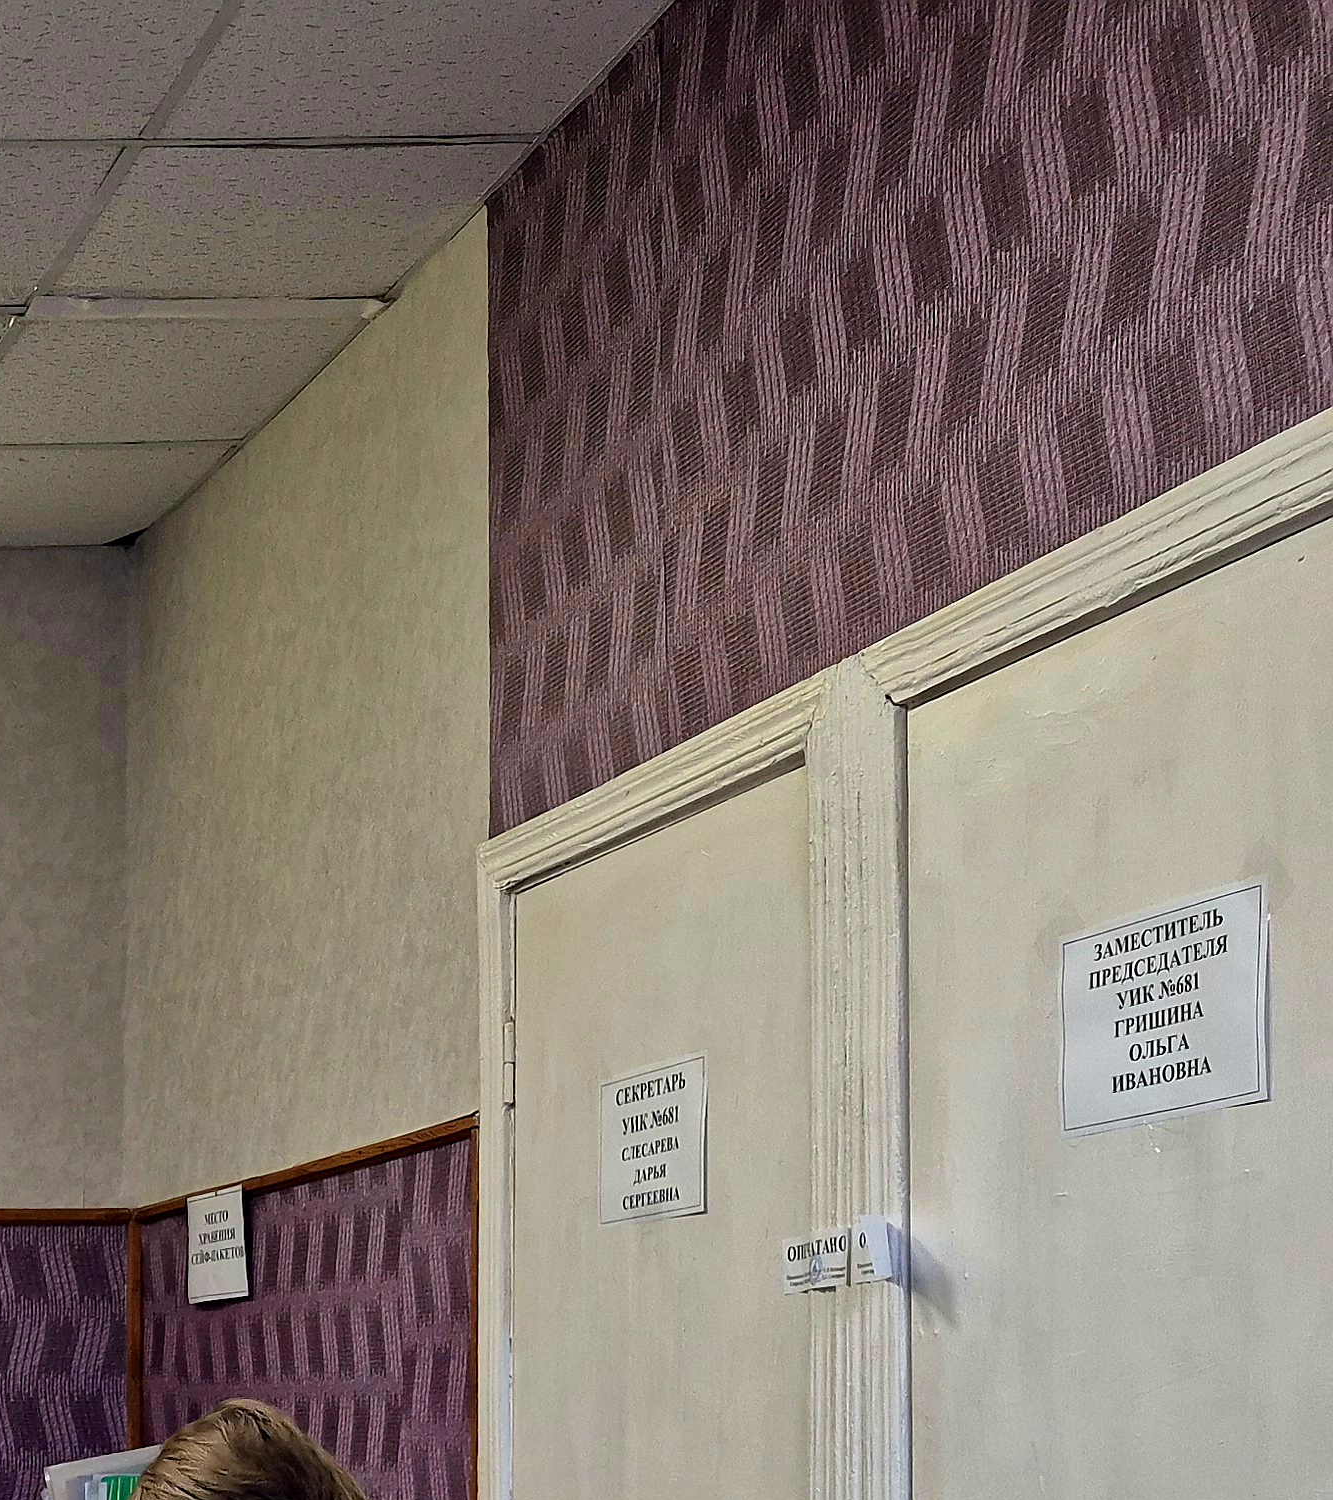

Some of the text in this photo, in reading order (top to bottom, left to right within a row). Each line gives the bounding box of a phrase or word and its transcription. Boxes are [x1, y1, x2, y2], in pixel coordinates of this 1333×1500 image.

[1093, 908, 1224, 961] ЗАМЕСТИТЕЛЬ
[1088, 934, 1229, 990] ПРЕДСЕДАТЕЛЯ
[1116, 971, 1200, 1010] УИК №681
[1113, 1000, 1204, 1038] ГРИШИНА
[1129, 1033, 1190, 1062] ОЛЬГА
[615, 1071, 686, 1107] СЕКРЕТАРЬ
[1111, 1056, 1212, 1094] ИВАНОВНА
[621, 1105, 680, 1136] УИК №681
[621, 1136, 680, 1162] СЛЕСАРЕВА
[633, 1163, 667, 1186] ДАРЬЯ
[622, 1186, 680, 1211] СЕРГЕЕВНА
[204, 1209, 229, 1226] МЕСТО
